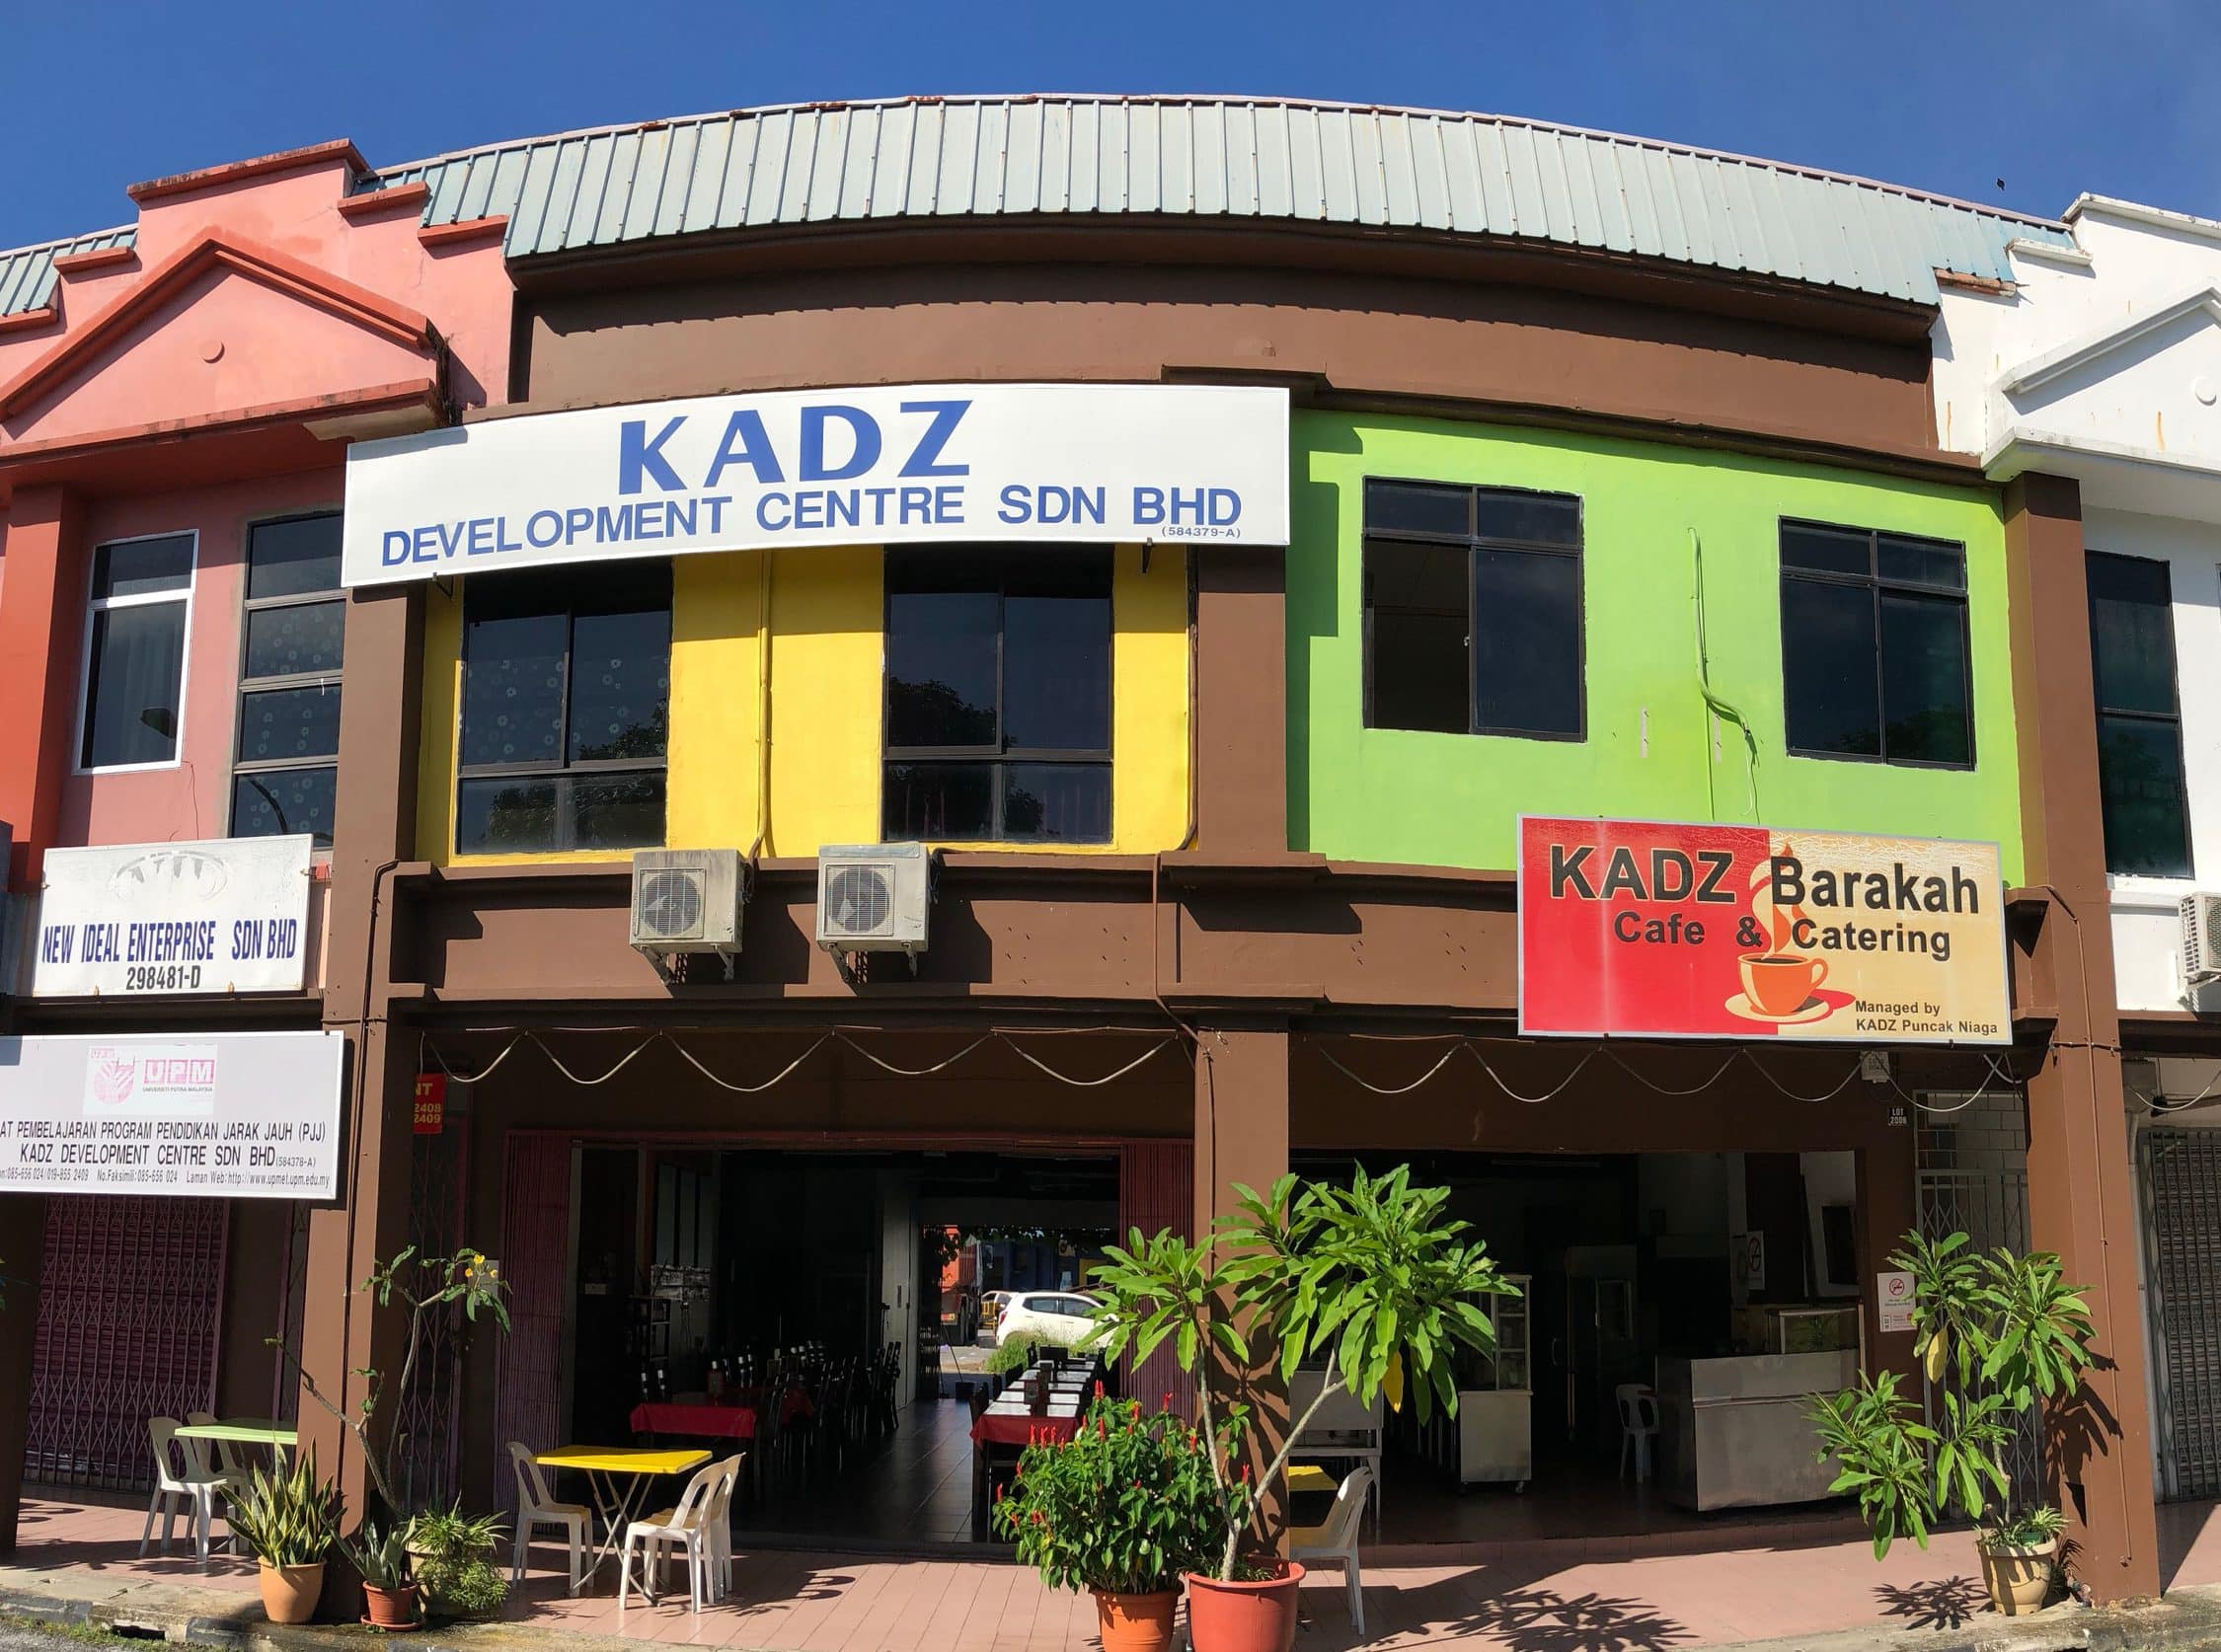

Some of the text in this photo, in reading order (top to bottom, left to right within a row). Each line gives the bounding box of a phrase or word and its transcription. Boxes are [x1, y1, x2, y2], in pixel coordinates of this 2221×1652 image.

[619, 400, 972, 494] KADZ
[383, 485, 1241, 567] DEVELOPMENT CENTRE SDN BHD (584379-A)
[1550, 844, 1980, 915] KADZ Barakah
[41, 918, 298, 964] NEW IDEAL ENTERPRISE SDN BHD
[1614, 911, 1953, 961] Cafe & Catering
[125, 964, 201, 991] 298481-D
[1856, 1000, 1942, 1018] Managed by
[1856, 1018, 1999, 1036] KADZ Puncak Niaga
[145, 1061, 213, 1084] UPM
[17, 1121, 97, 1139] PEMBELAJARAN
[101, 1121, 152, 1140] PROGRAM
[157, 1122, 218, 1140] PENDIDIKAN
[223, 1122, 260, 1141] JARAK
[265, 1122, 292, 1141] JAUH
[298, 1121, 326, 1143] (PJJ)
[20, 1143, 54, 1163] KADZ
[61, 1144, 150, 1164] DEVELOPMENT
[157, 1145, 206, 1165] CENTRE
[215, 1145, 241, 1165] SDN
[250, 1146, 275, 1166] BHD
[187, 1170, 208, 1183] Laman
